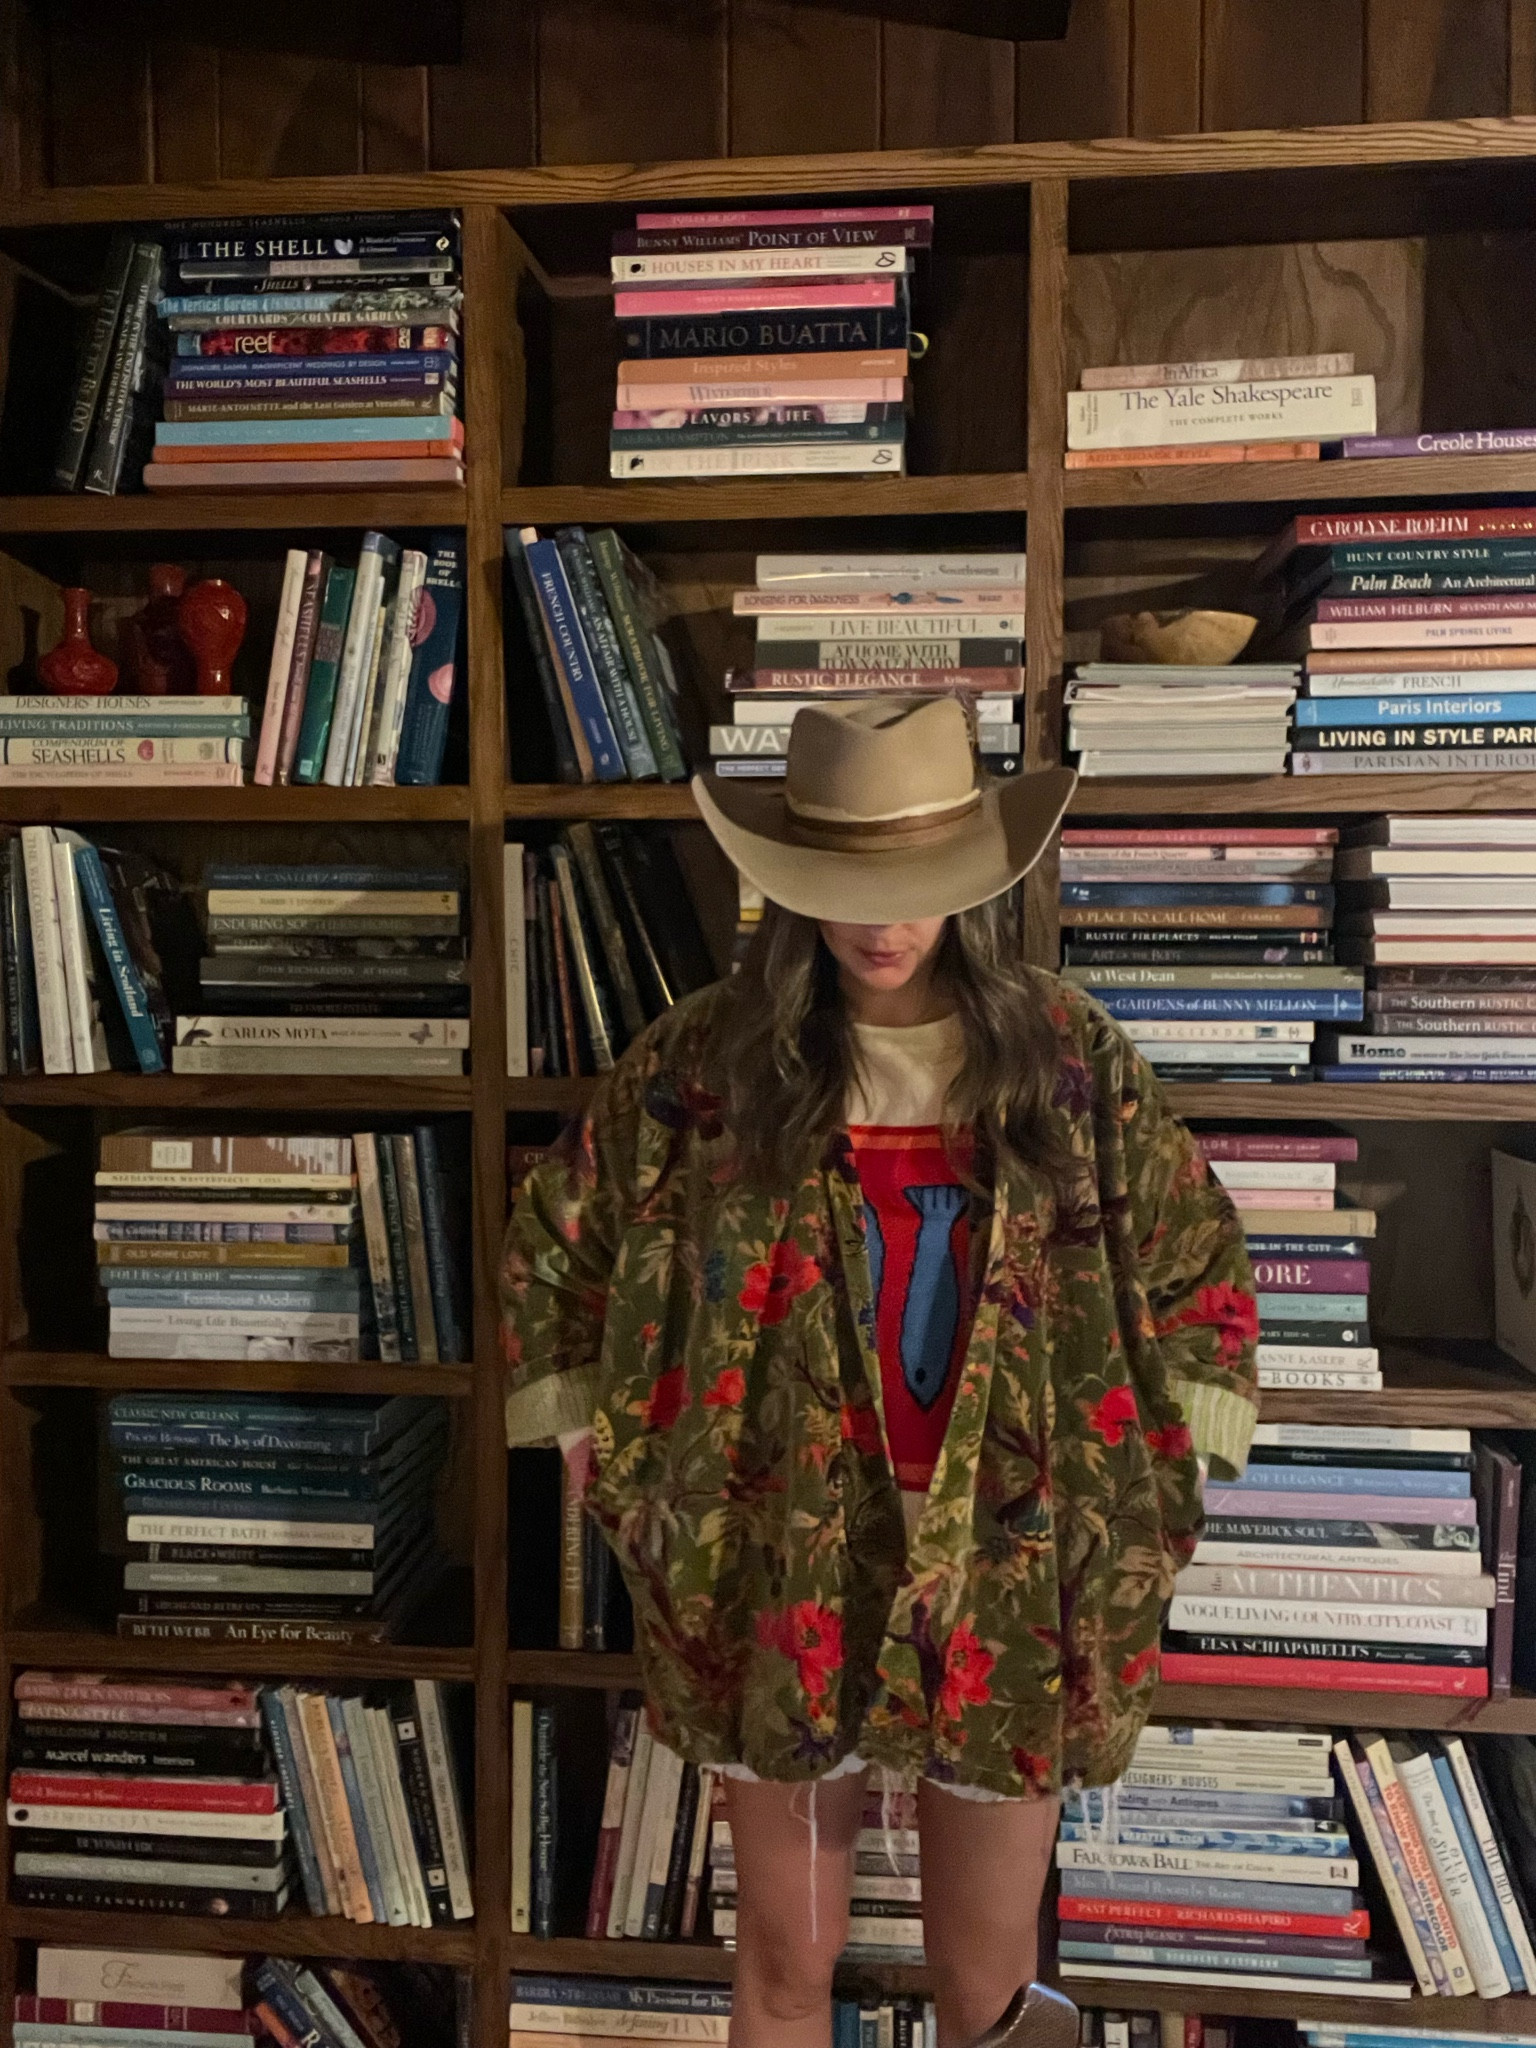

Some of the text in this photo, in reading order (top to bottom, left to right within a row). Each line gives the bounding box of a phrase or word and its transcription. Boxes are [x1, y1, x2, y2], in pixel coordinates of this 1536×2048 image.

[748, 225, 878, 247] POINT OF VIEW
[197, 239, 327, 257] THE SHELL
[652, 256, 823, 274] HOUSES IN MY HEART
[234, 331, 276, 353] reef
[658, 320, 867, 349] MARIO BUATTA
[693, 357, 796, 375] Inspired Styles
[176, 374, 386, 390] THE WORLD'S MOST BEAUTIFUL SEASHELLS
[1120, 379, 1332, 410] The Yale Shakespeare
[1191, 414, 1245, 425] COMPLETE
[1249, 411, 1282, 421] WORKS
[1416, 432, 1473, 454] Creole
[1310, 515, 1468, 537] CAROLYNE ROEHM
[1346, 546, 1490, 563] HUNT COUNTRY STYLE
[1350, 570, 1431, 591] Palm Beach
[1441, 576, 1460, 589] An
[1330, 601, 1452, 618] WILLIAM HELBURN
[539, 571, 585, 682] FRENCH COUNTRY
[591, 614, 603, 631] AN
[830, 617, 981, 635] LIVE BEAUTIFUL
[1486, 625, 1512, 635] LIVING
[836, 643, 947, 657] AT HOME WITH
[772, 670, 920, 687] RUSTIC ELEGANCE
[1402, 674, 1461, 690] FRENCH
[617, 697, 627, 707] A
[1378, 696, 1501, 716] Paris Interiors
[50, 718, 133, 731] TRADITIONS
[619, 707, 638, 742] HOUSE
[1318, 729, 1385, 747] LIVING
[1394, 729, 1415, 744] IN
[1423, 728, 1484, 746] STYLE
[32, 745, 125, 765] SEASHELLS
[96, 906, 143, 1019] Living in Scotland
[1090, 970, 1174, 980] At West Dean
[1116, 999, 1316, 1010] GARDENS of BUNNY MELLON
[1410, 997, 1474, 1009] Southern
[1478, 999, 1523, 1009] RUSTIC
[221, 1027, 327, 1038] CARLOS MOTA
[1416, 1018, 1480, 1031] Southern
[1483, 1021, 1530, 1031] RUSTIC
[1351, 1044, 1406, 1057] Home
[1254, 1262, 1311, 1284] ORE
[168, 1315, 288, 1329] Living Life Beautifully
[1271, 1373, 1344, 1385] BOOKS
[207, 1433, 231, 1445] The
[233, 1436, 248, 1450] Joy
[253, 1434, 266, 1447] of
[121, 1454, 141, 1464] THE
[183, 1457, 238, 1468] AMERICAN
[124, 1472, 252, 1493] GRACIOUS ROOMS
[140, 1523, 266, 1540] THE PERFECT BATH
[1229, 1569, 1442, 1603] AUTHENTICS
[1183, 1604, 1234, 1619] VOGUE
[1407, 1615, 1453, 1630] COAST
[133, 1623, 209, 1637] BETH WEBB
[227, 1624, 353, 1645] An Eye for Beauty
[1201, 1636, 1237, 1650] ELSA
[90, 1749, 147, 1764] wanders
[1382, 1787, 1449, 1951] TO KNOW ABOUT WATERCOLOR
[1388, 1780, 1458, 1948] EVERYTHING YOU EVER WANTED
[1428, 1833, 1464, 1897] SILVER
[1449, 1846, 1469, 1883] OLD
[1480, 1837, 1516, 1905] THE BED
[1176, 1908, 1234, 1921] RICHARD
